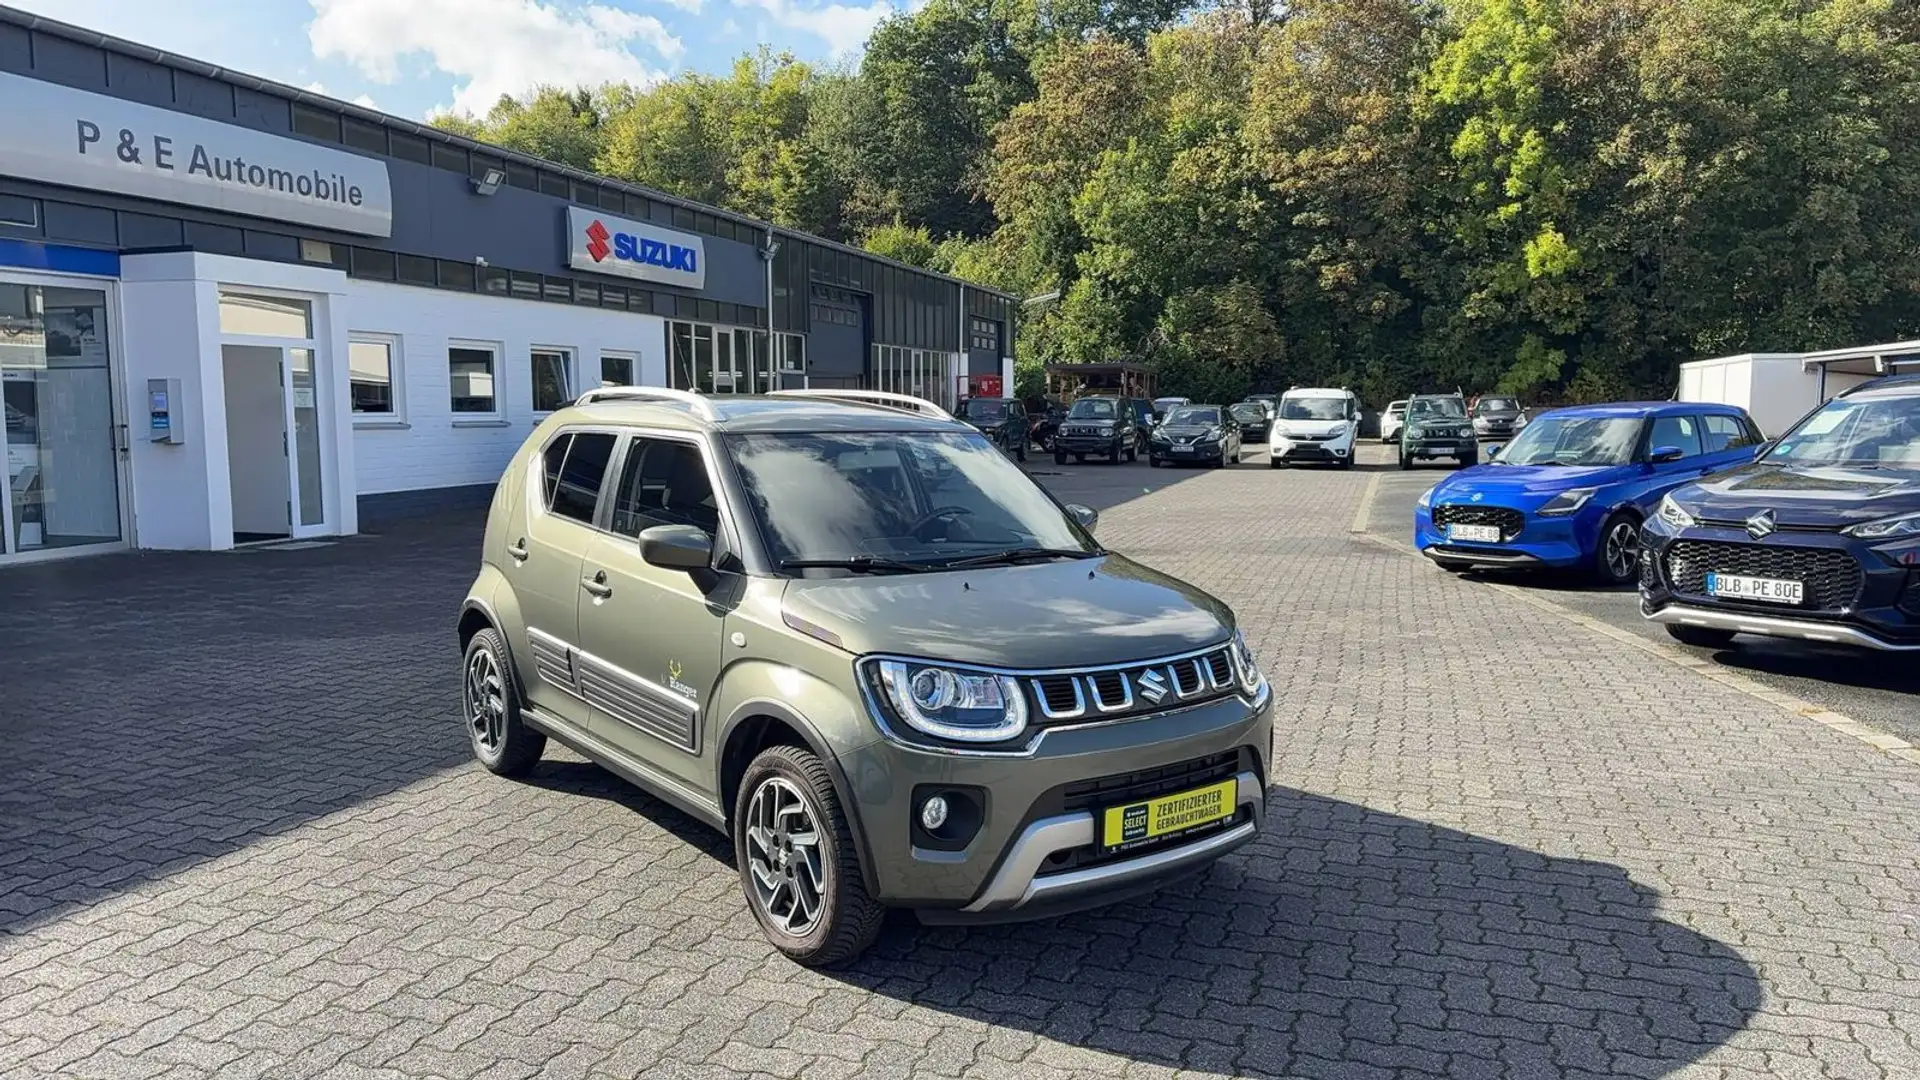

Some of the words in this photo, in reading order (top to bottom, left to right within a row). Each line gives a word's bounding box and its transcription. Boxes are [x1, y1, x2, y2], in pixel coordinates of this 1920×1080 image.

[76, 119, 101, 155] P
[116, 128, 143, 166] &
[153, 135, 174, 171] E
[188, 143, 363, 207] Automobile
[614, 232, 697, 273] SUZUKI
[1716, 577, 1741, 593] BLB
[1753, 580, 1770, 597] PE
[1774, 582, 1801, 599] 80E
[1156, 789, 1223, 818] ZERTIFIZIERTER
[1124, 814, 1148, 831] SELECT
[1156, 805, 1222, 831] GEBRAUCHTWAGEN
